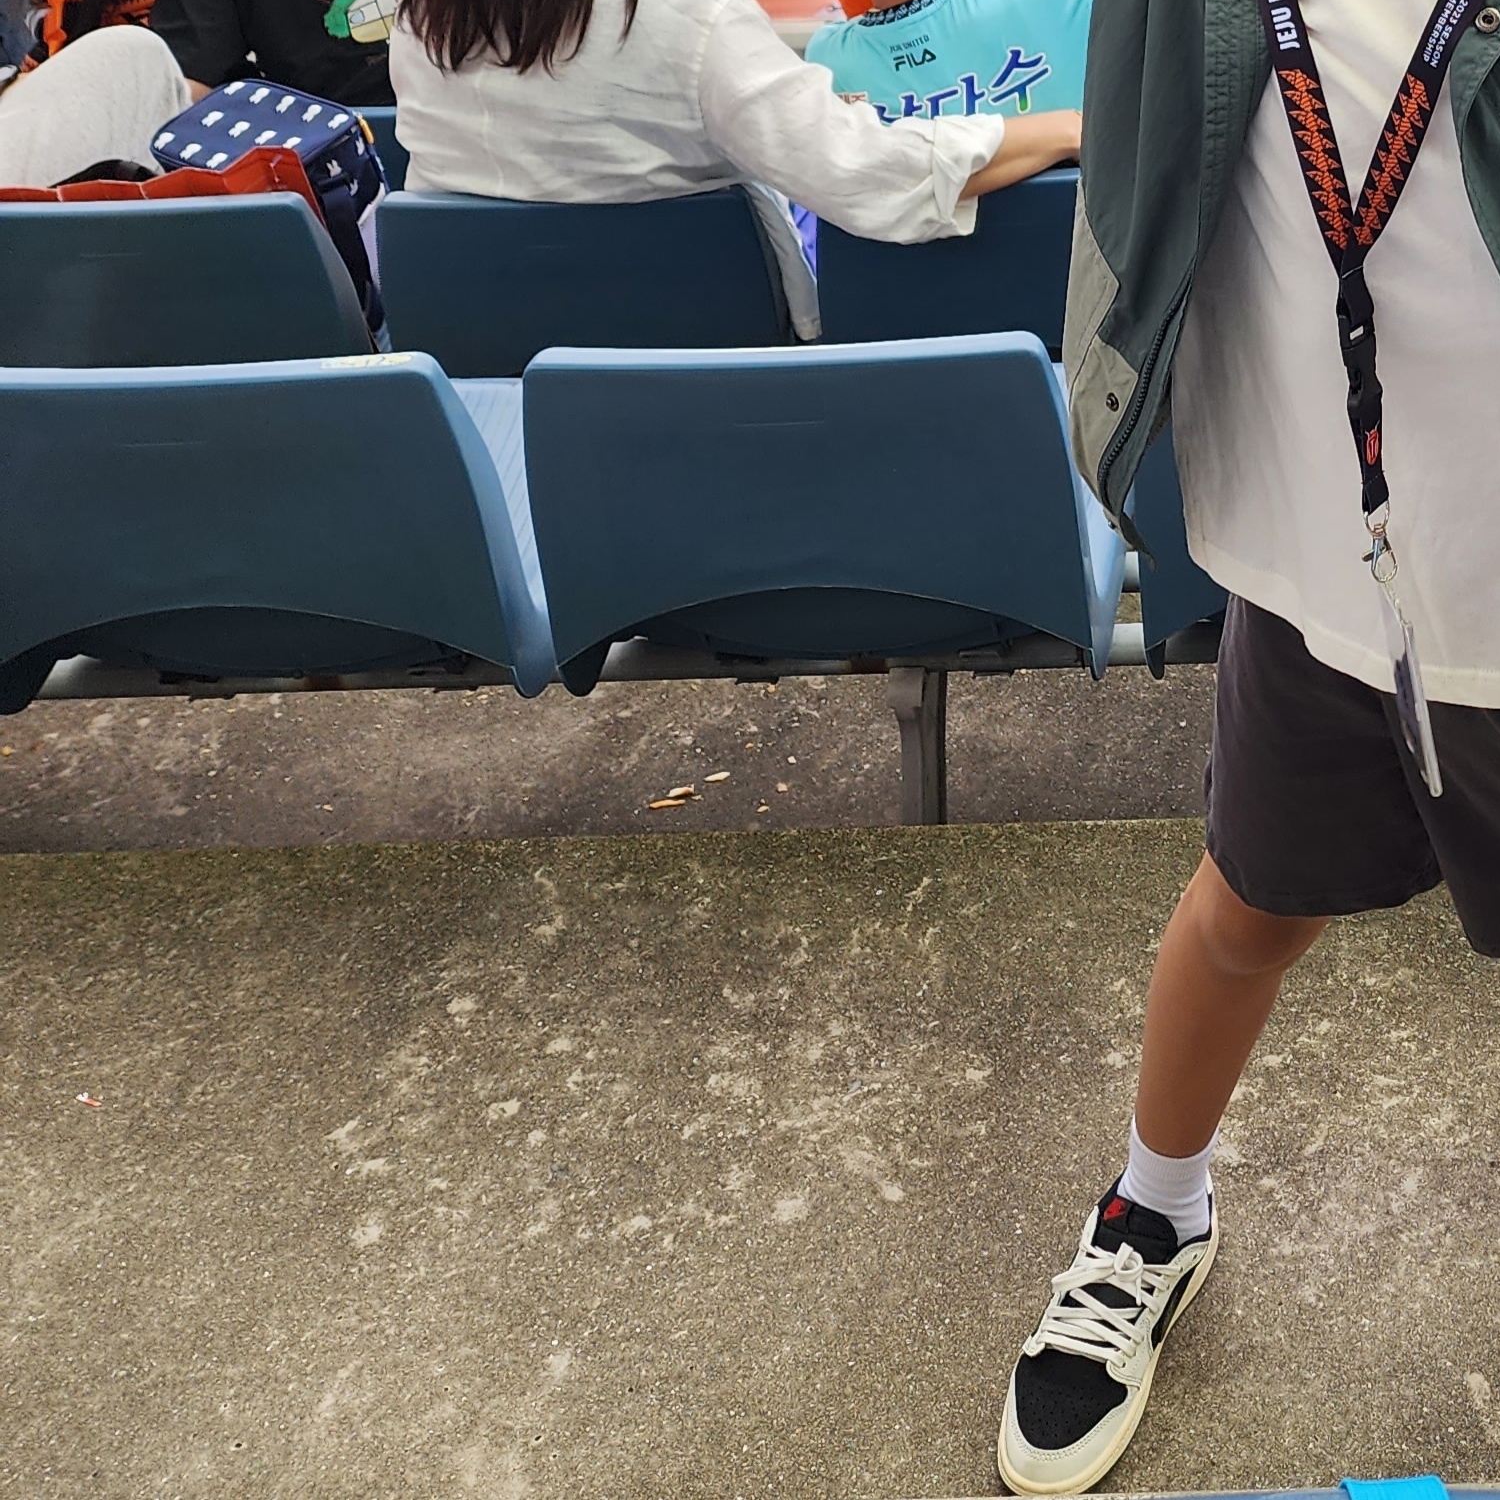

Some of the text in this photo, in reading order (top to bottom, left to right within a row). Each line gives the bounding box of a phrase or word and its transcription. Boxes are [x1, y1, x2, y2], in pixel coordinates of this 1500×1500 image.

[902, 35, 930, 49] UNITED
[1271, 6, 1301, 51] JEJU
[1430, 0, 1469, 68] 2023 SEASON
[893, 48, 937, 72] FILA
